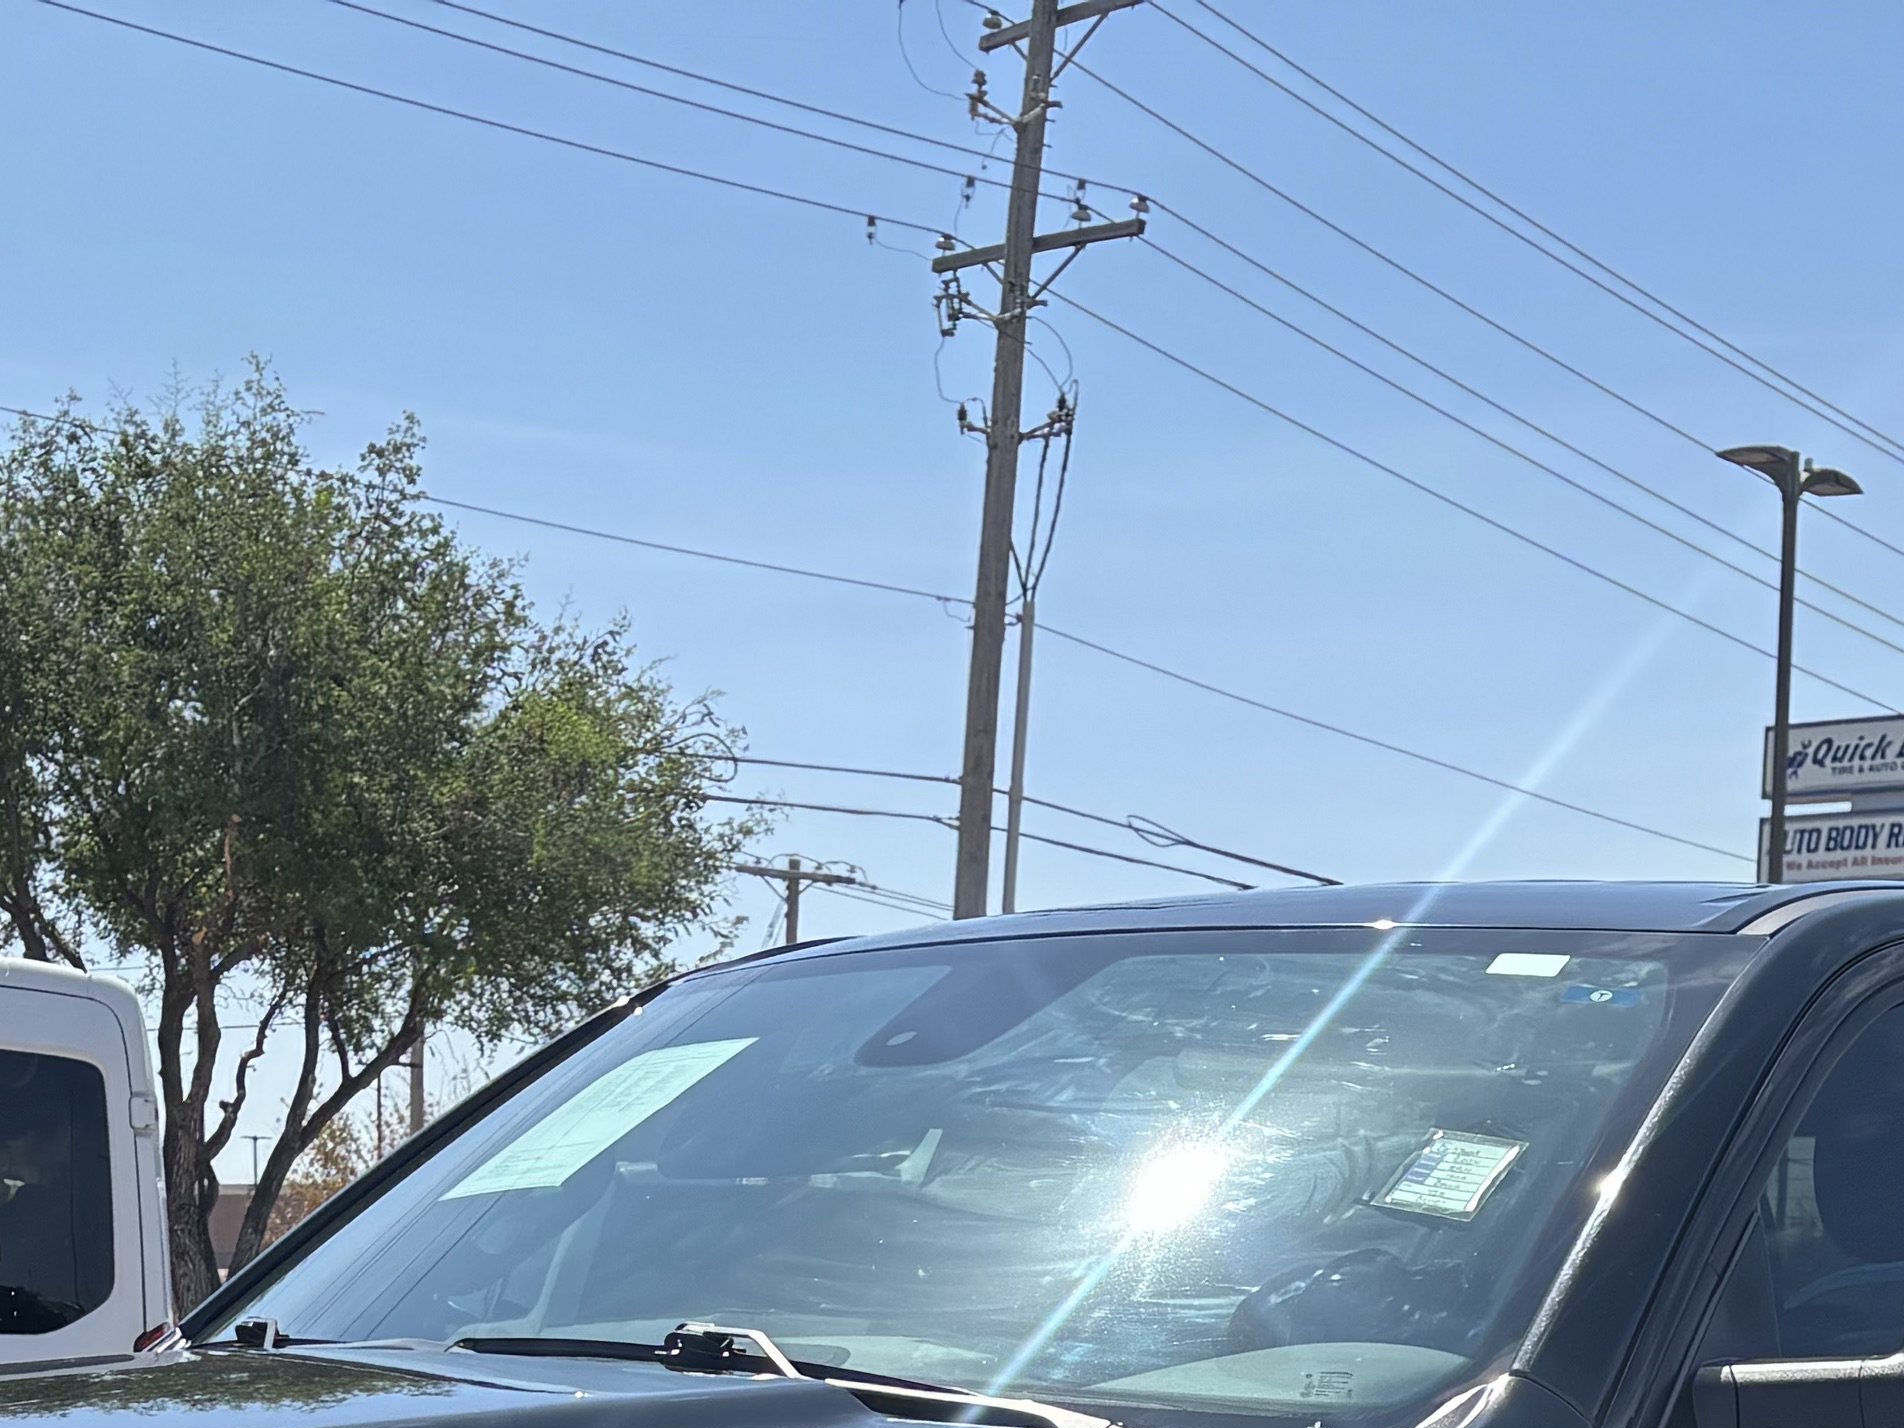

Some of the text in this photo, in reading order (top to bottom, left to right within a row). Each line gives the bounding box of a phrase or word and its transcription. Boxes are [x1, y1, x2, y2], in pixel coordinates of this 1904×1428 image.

[1812, 733, 1893, 768] Quick
[1783, 827, 1822, 855] UTO
[1824, 823, 1884, 852] BODY
